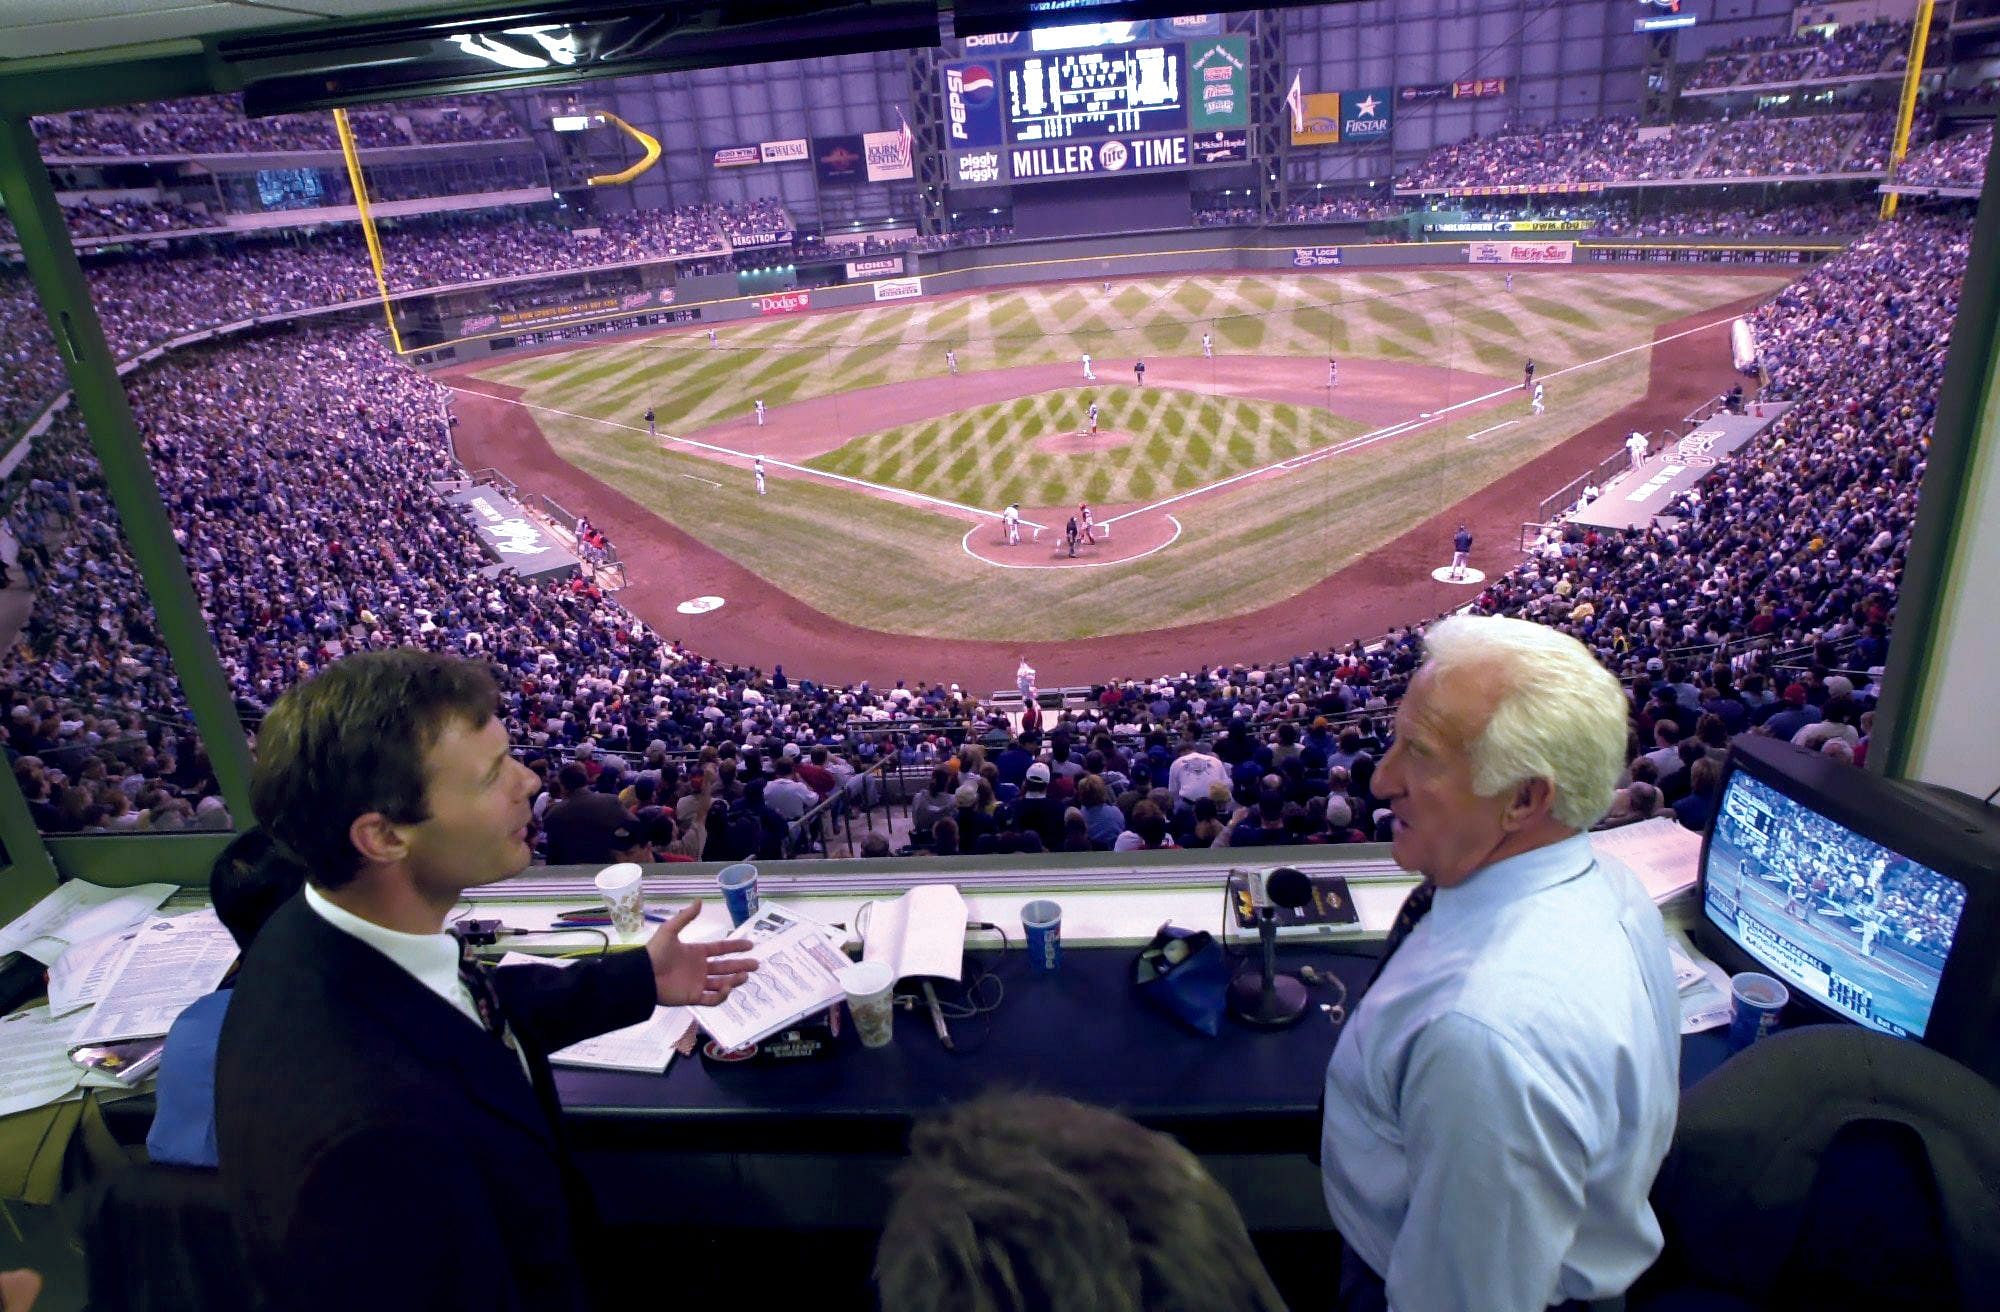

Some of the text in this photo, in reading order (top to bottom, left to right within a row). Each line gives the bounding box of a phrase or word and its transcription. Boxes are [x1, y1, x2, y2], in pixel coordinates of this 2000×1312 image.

[947, 69, 968, 140] PEPSI
[1345, 119, 1387, 133] FIRSTAR
[959, 152, 998, 169] piggly
[1013, 137, 1187, 178] MILLER TIME
[958, 167, 999, 182] wiggly
[762, 296, 798, 312] Dodge
